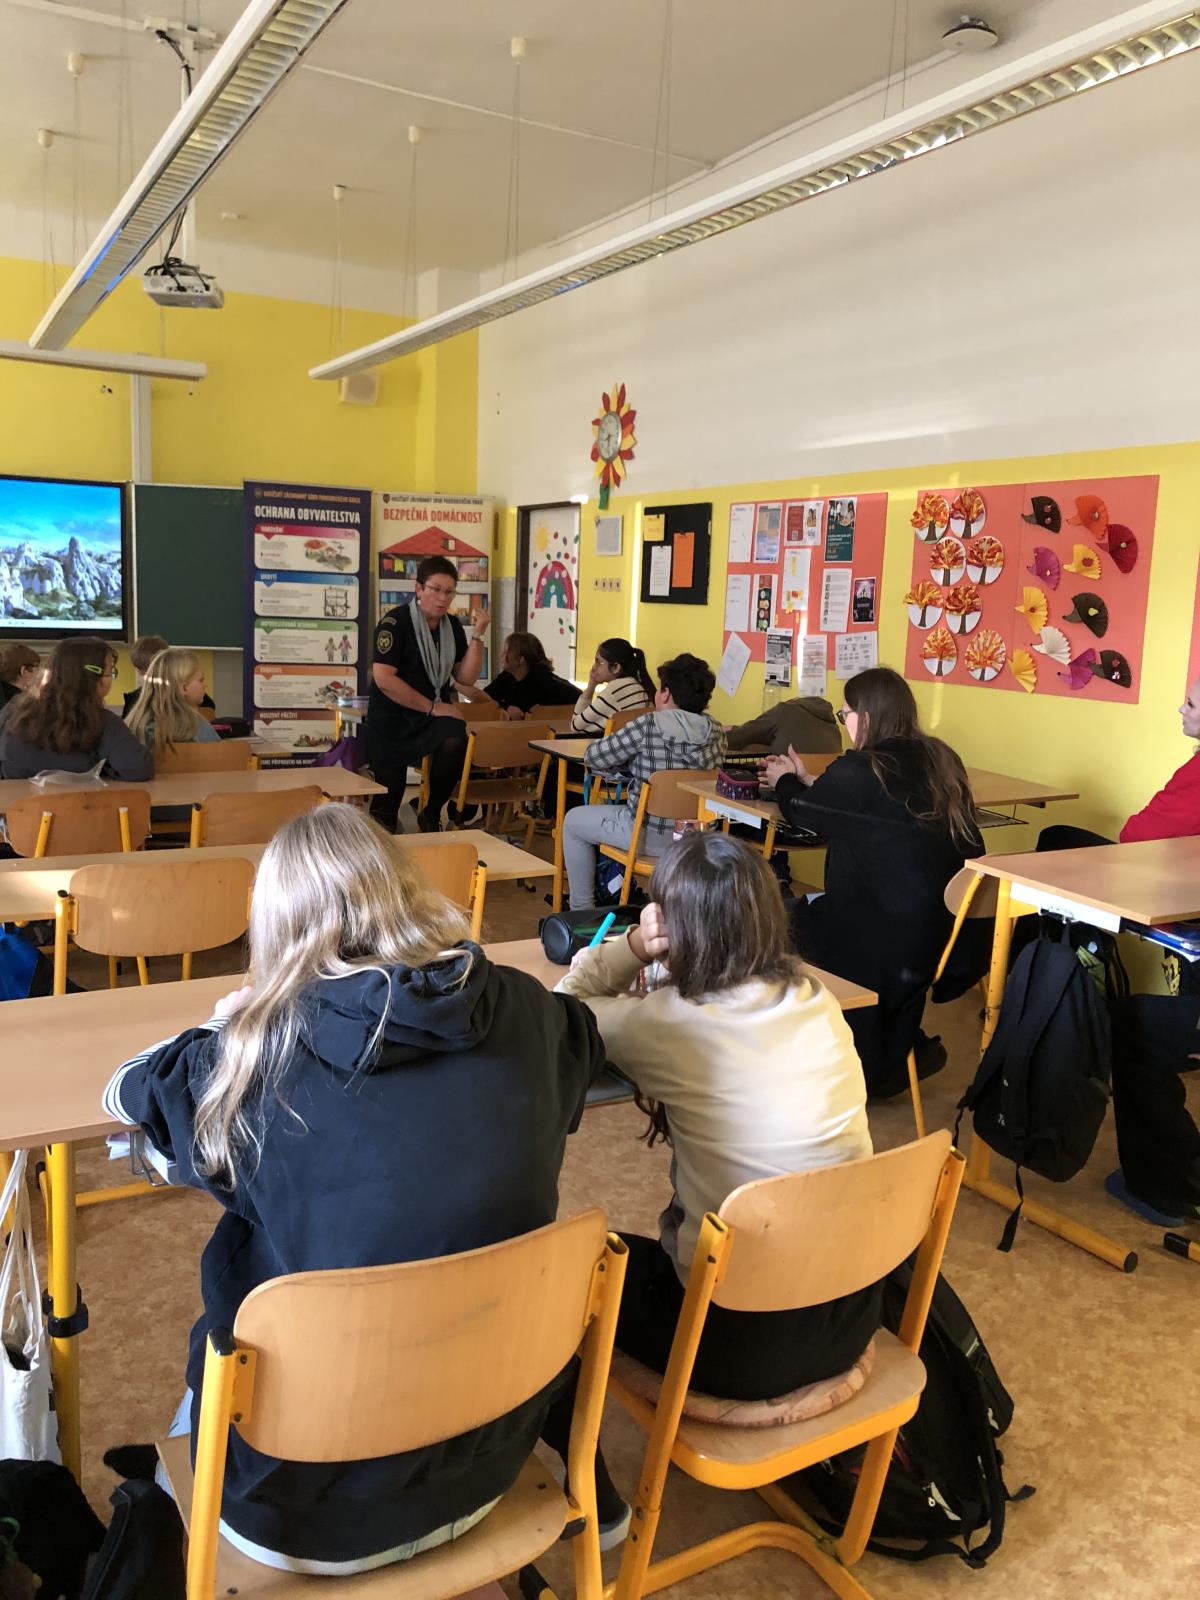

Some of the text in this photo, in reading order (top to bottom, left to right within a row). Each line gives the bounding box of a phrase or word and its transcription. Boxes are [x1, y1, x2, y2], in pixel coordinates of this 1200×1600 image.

[254, 505, 361, 524] OCHRANA OBYVATELSTVA
[383, 507, 484, 524] BEZPEČNÁ DOMÁCNOST
